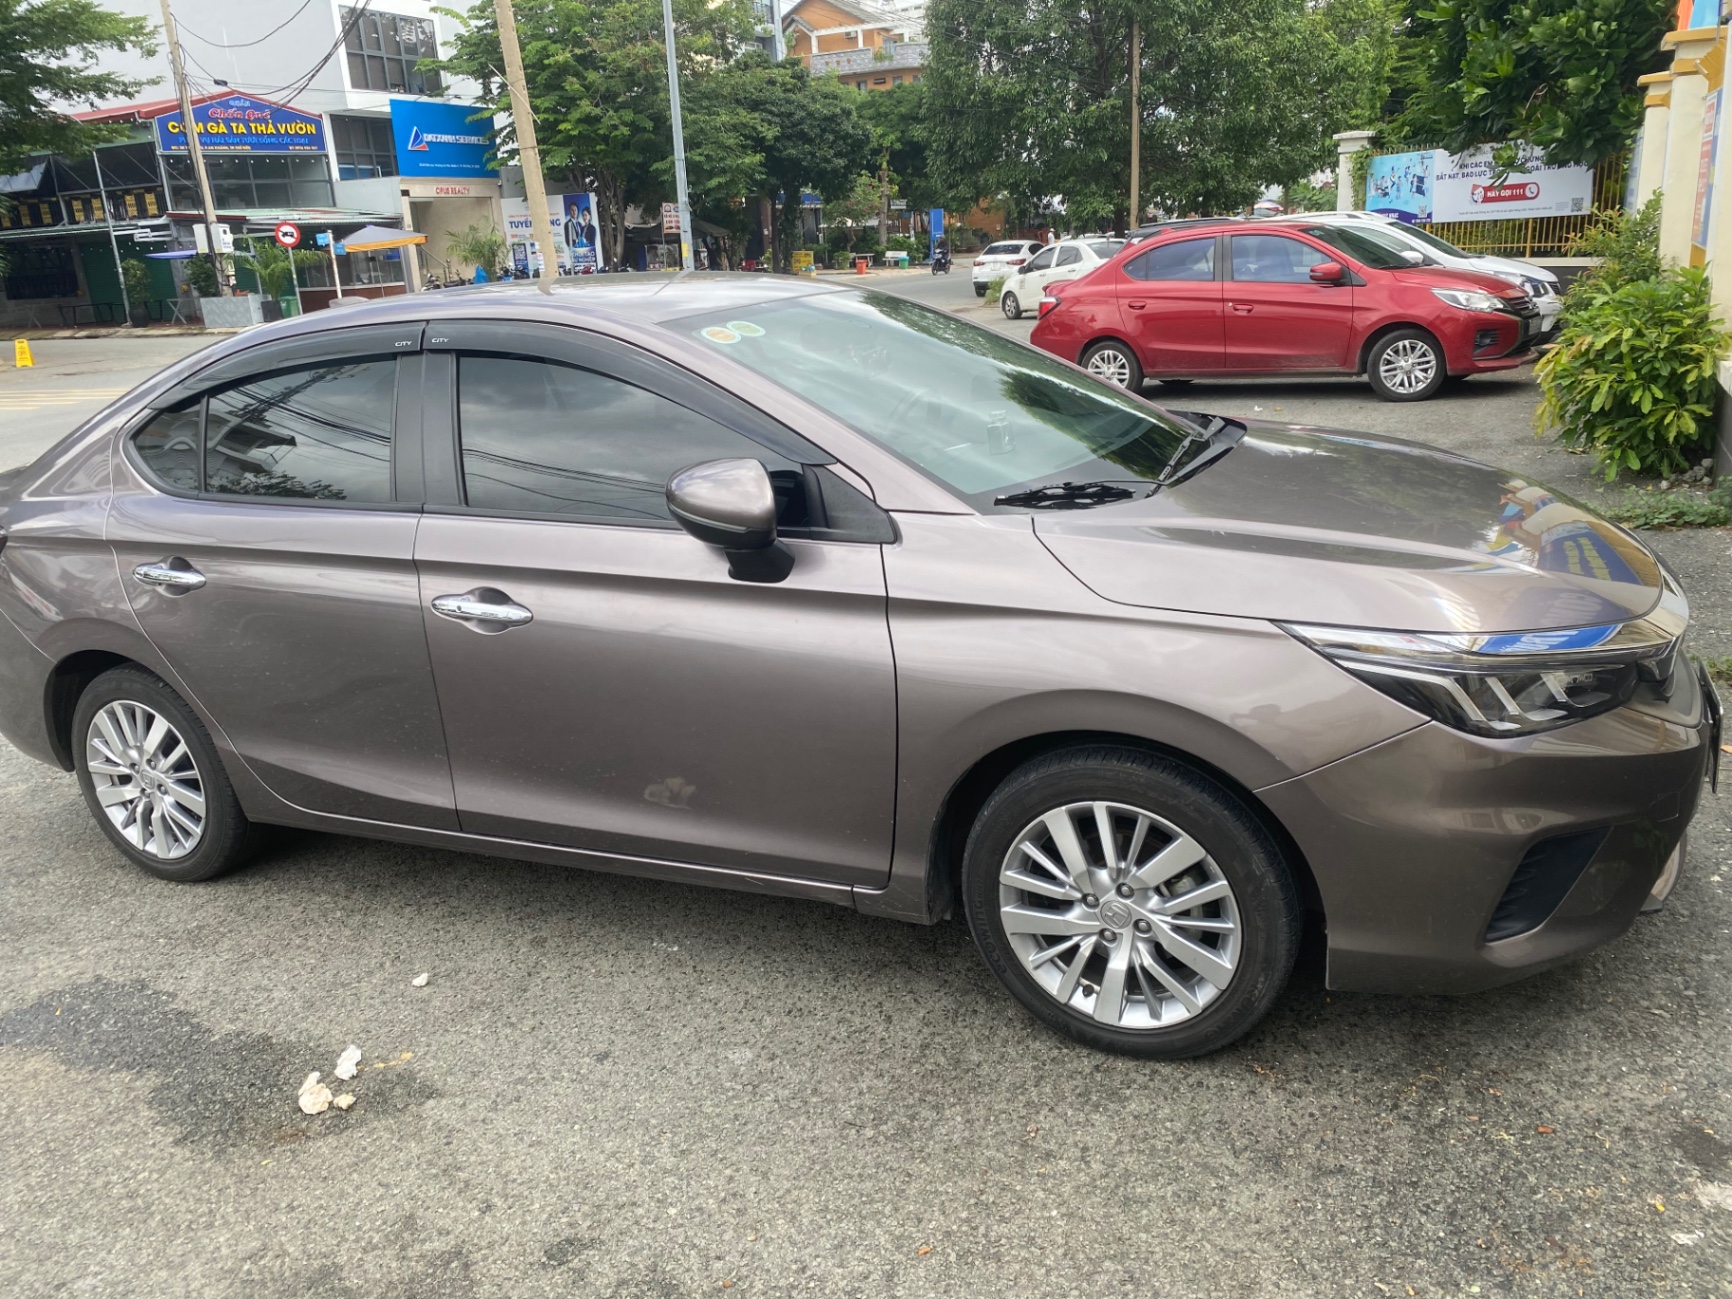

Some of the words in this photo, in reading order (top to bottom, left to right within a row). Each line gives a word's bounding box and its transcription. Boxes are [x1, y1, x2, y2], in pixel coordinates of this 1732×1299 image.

[207, 119, 228, 134] GÀ
[230, 122, 247, 134] TA
[250, 119, 276, 134] THẢ
[276, 120, 316, 134] VƯỜN
